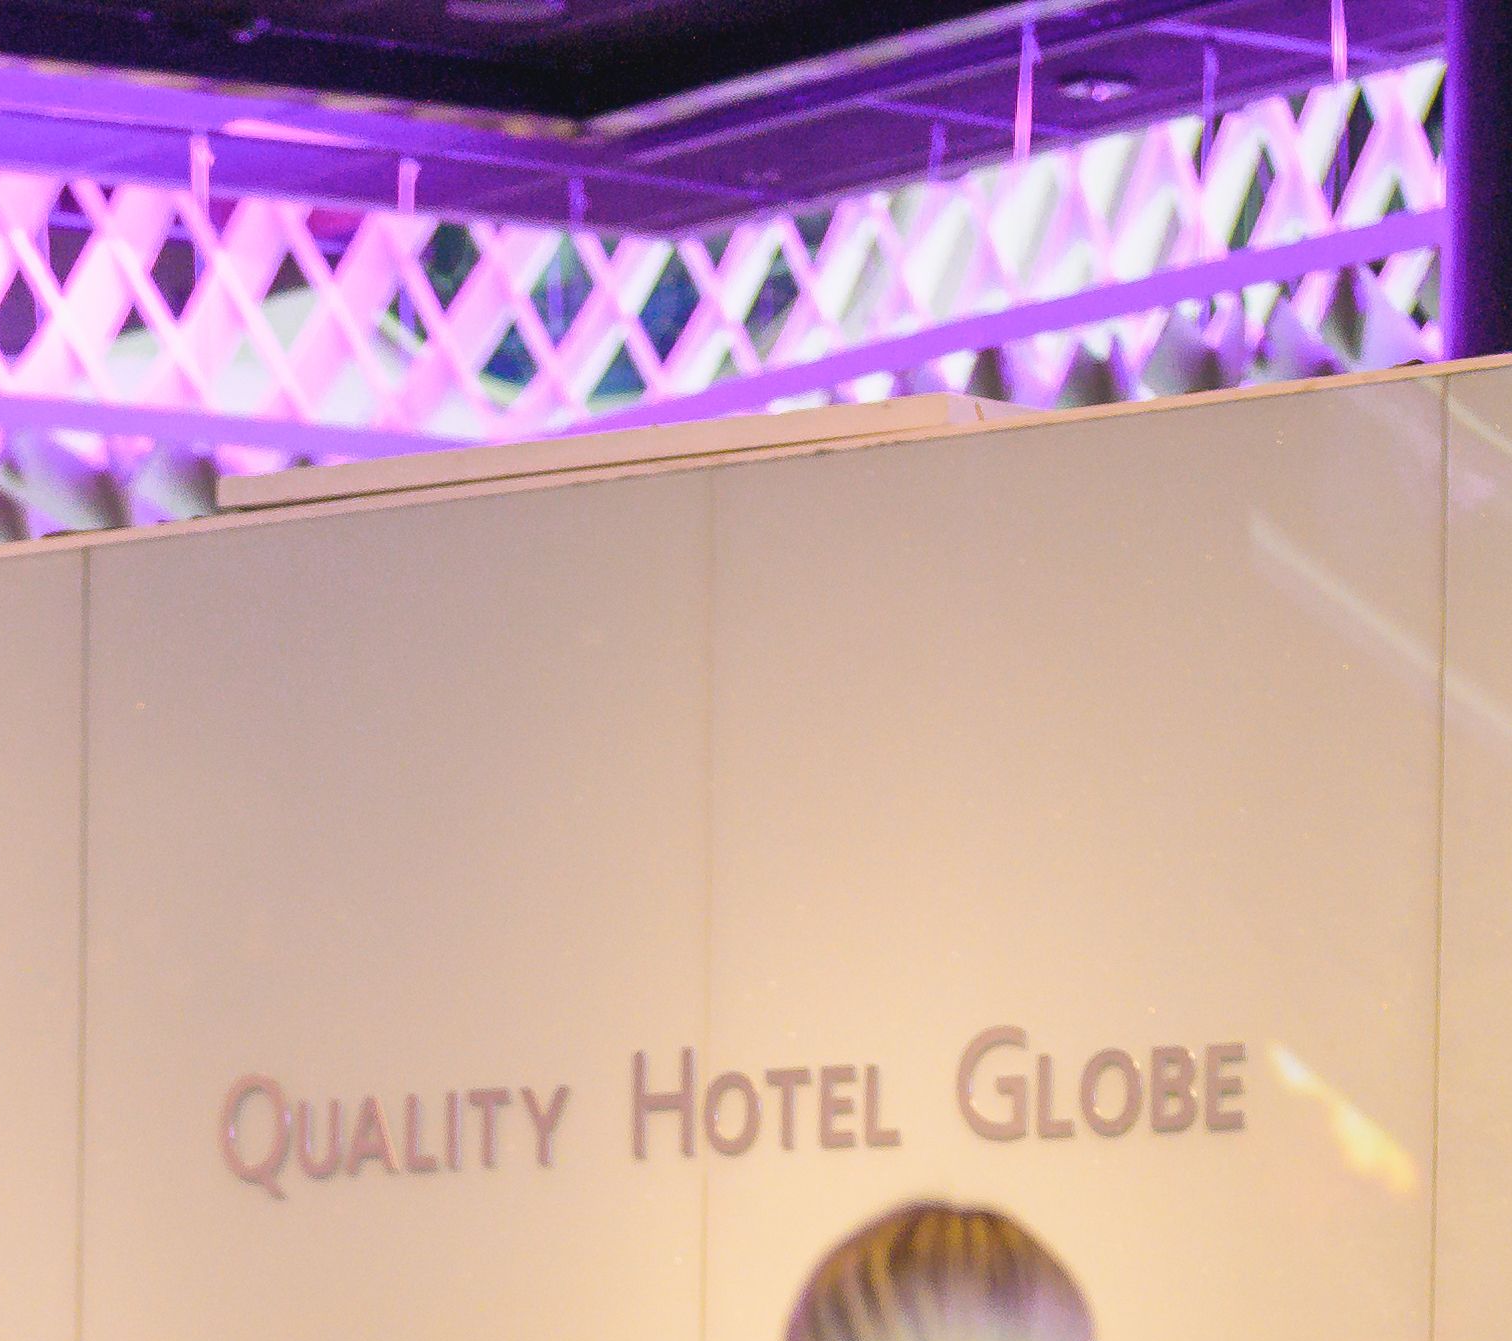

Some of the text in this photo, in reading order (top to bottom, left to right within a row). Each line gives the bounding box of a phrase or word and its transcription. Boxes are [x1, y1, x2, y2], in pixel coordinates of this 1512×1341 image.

[219, 1025, 1247, 1198] QUALITY HOTEL GLOBE
